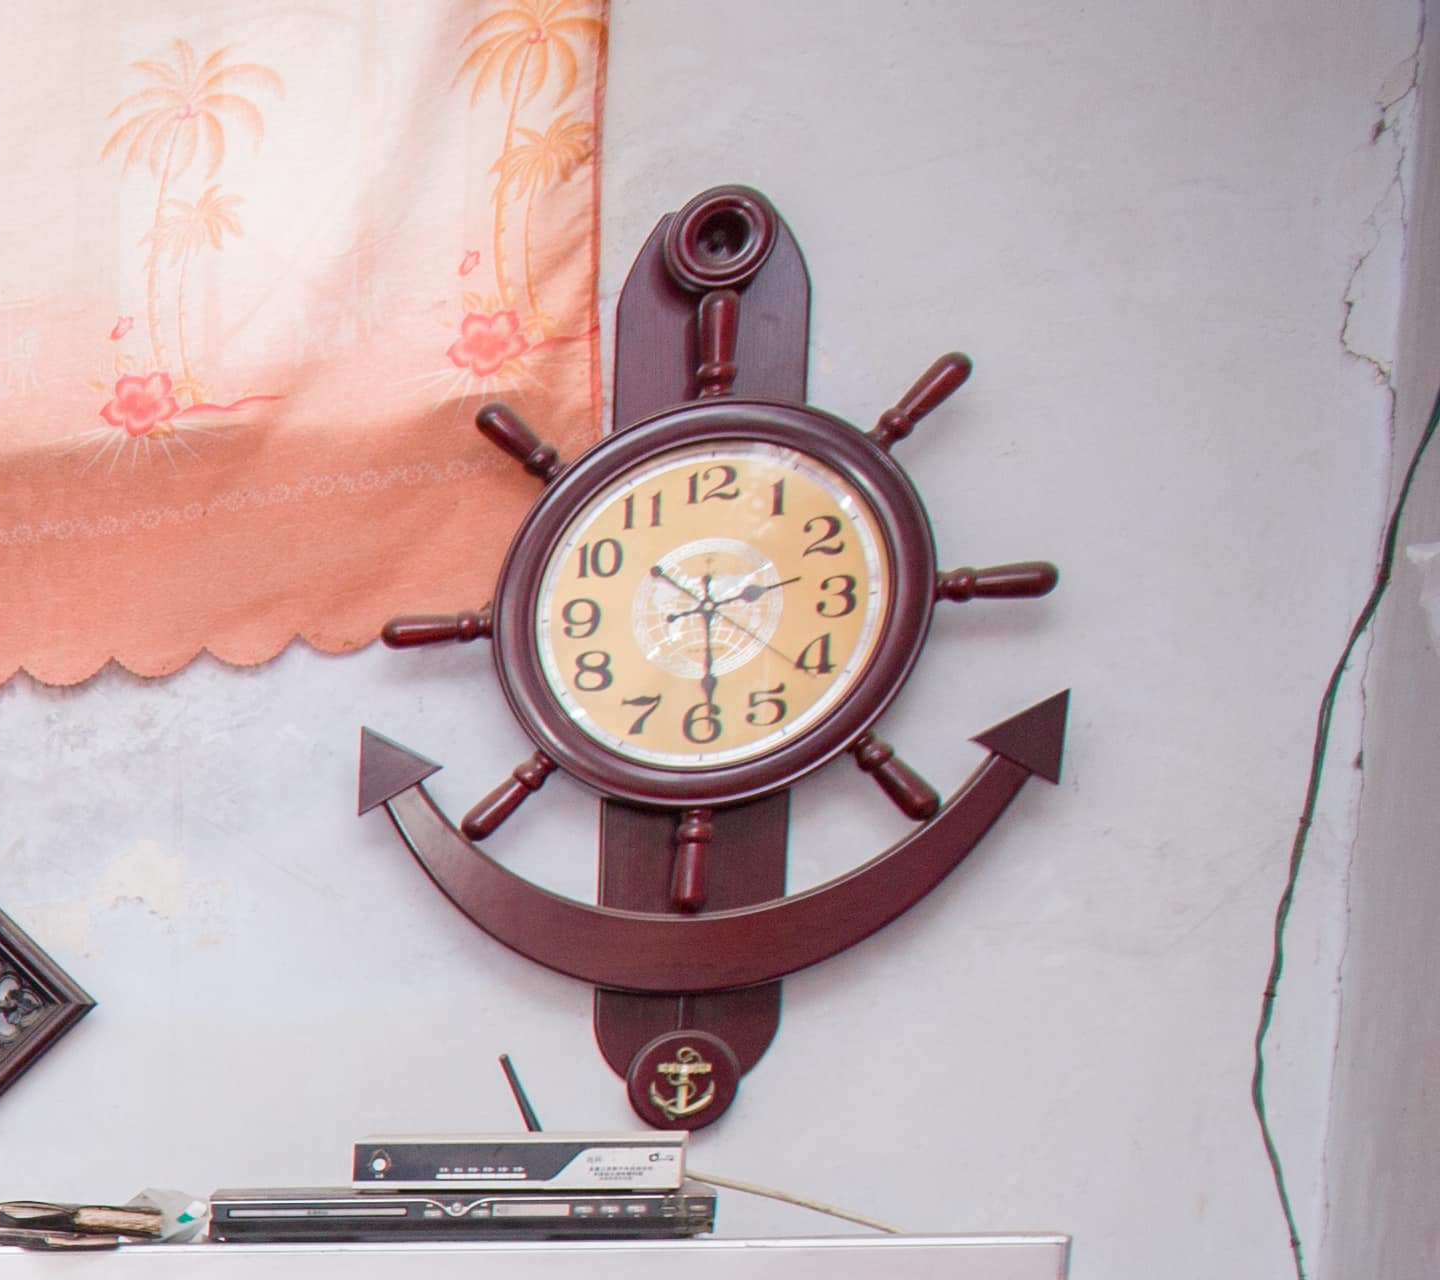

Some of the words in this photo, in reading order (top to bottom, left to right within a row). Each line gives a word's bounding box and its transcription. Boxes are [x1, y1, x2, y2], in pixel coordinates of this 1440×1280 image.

[687, 465, 740, 504] 12
[770, 478, 786, 516] 1
[623, 490, 663, 530] 11
[802, 515, 846, 558] 2
[577, 538, 623, 579] 10
[816, 574, 858, 618] 3
[561, 598, 602, 640] 9
[574, 650, 614, 692] 8
[794, 633, 838, 675] 4
[621, 693, 663, 735] 7
[682, 702, 723, 745] 6
[744, 683, 788, 728] 5
